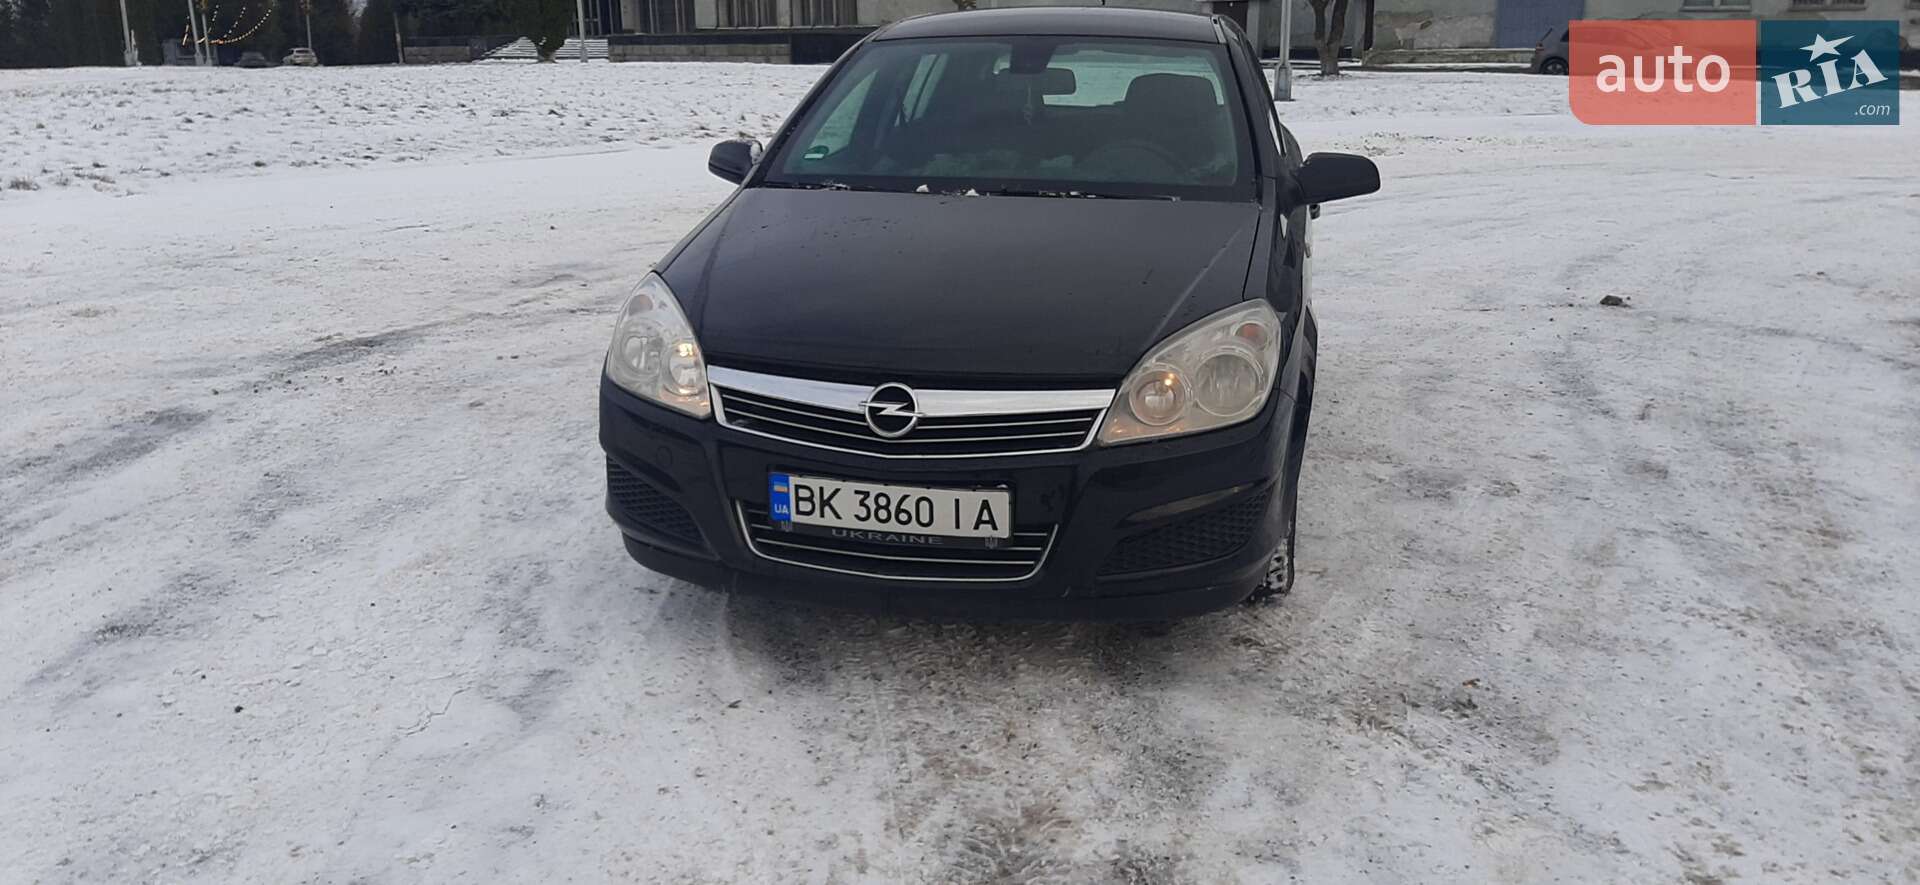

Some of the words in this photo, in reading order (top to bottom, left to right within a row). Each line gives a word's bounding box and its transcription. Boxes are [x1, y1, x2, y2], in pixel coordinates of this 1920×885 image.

[774, 503, 790, 515] UA
[793, 484, 842, 520] BK
[853, 489, 935, 528] 3860
[831, 528, 945, 546] UKRAINE
